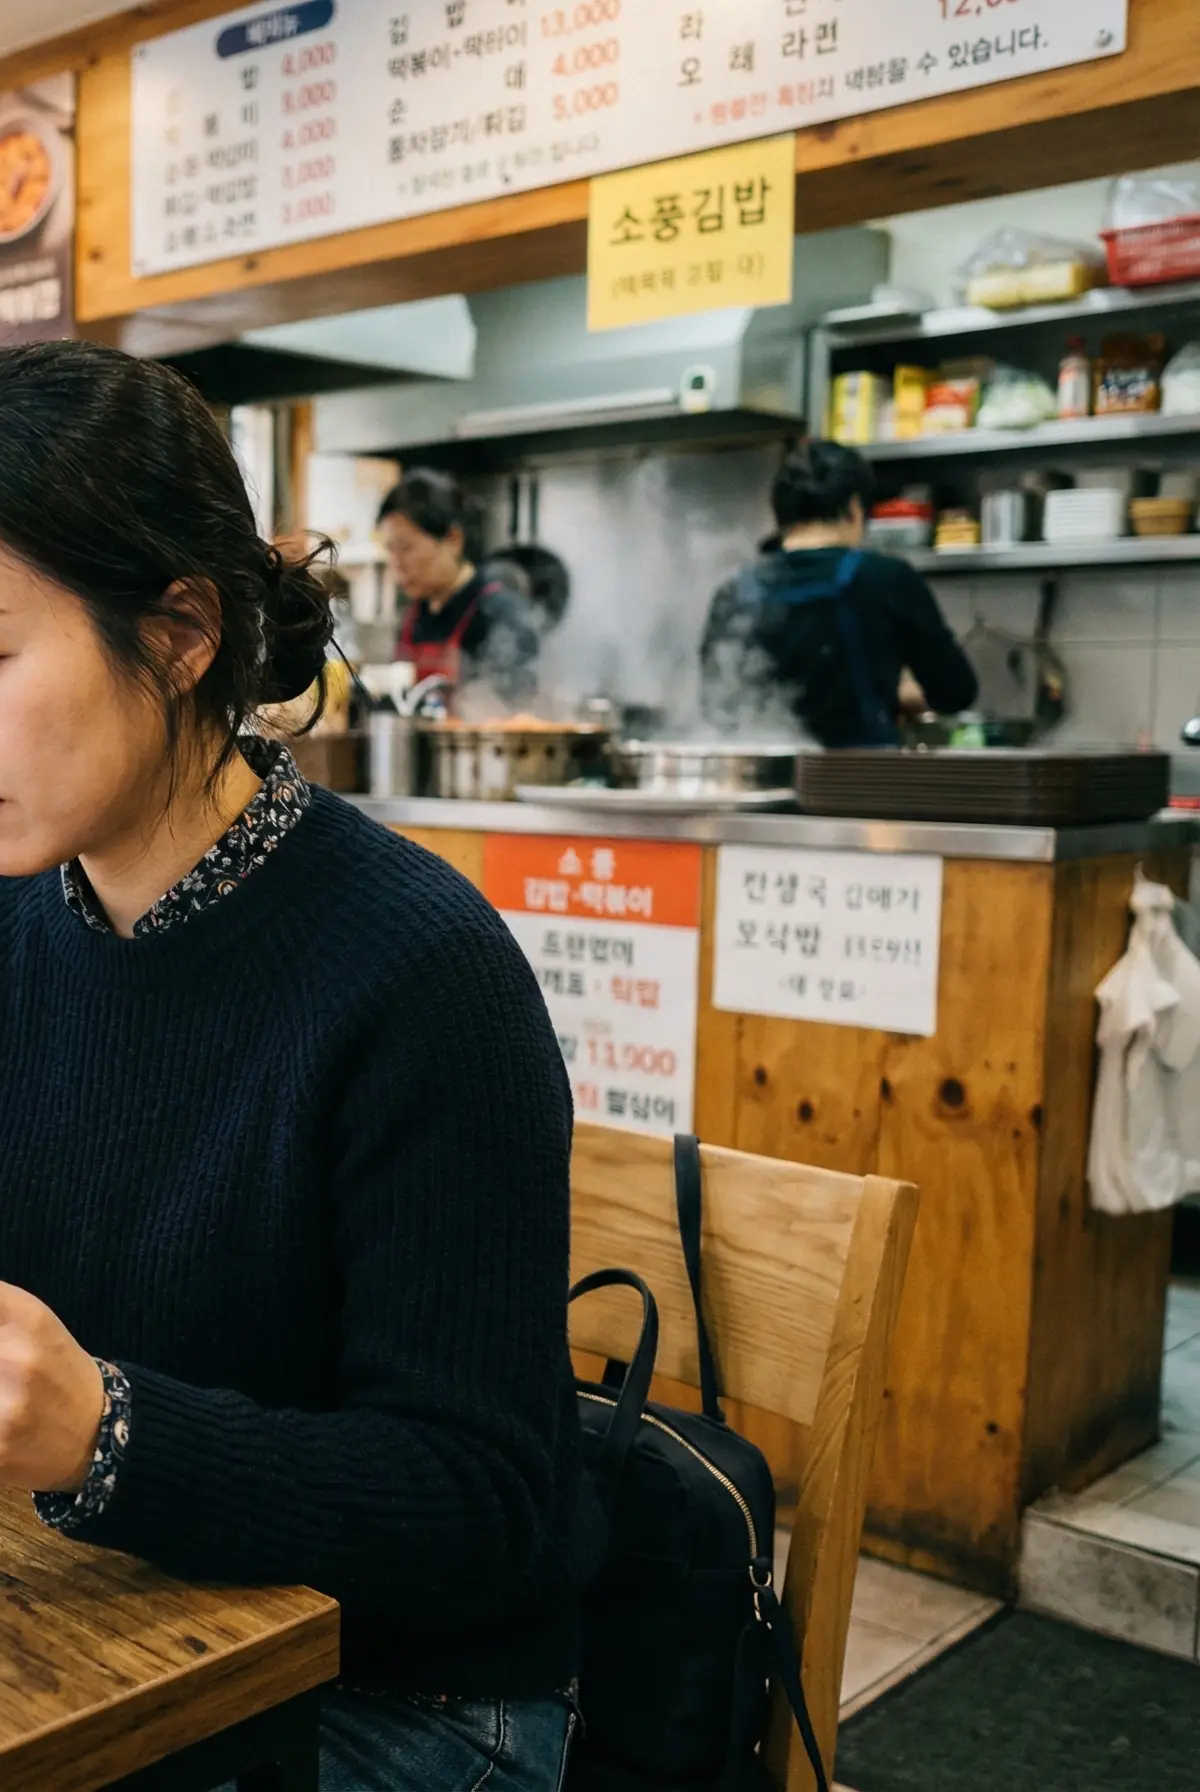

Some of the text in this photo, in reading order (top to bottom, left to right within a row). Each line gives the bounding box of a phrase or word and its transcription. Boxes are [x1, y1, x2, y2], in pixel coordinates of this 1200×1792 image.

[917, 50, 938, 76] 수
[949, 24, 1049, 69] 있습니다.
[610, 175, 773, 245] 소풍김밥
